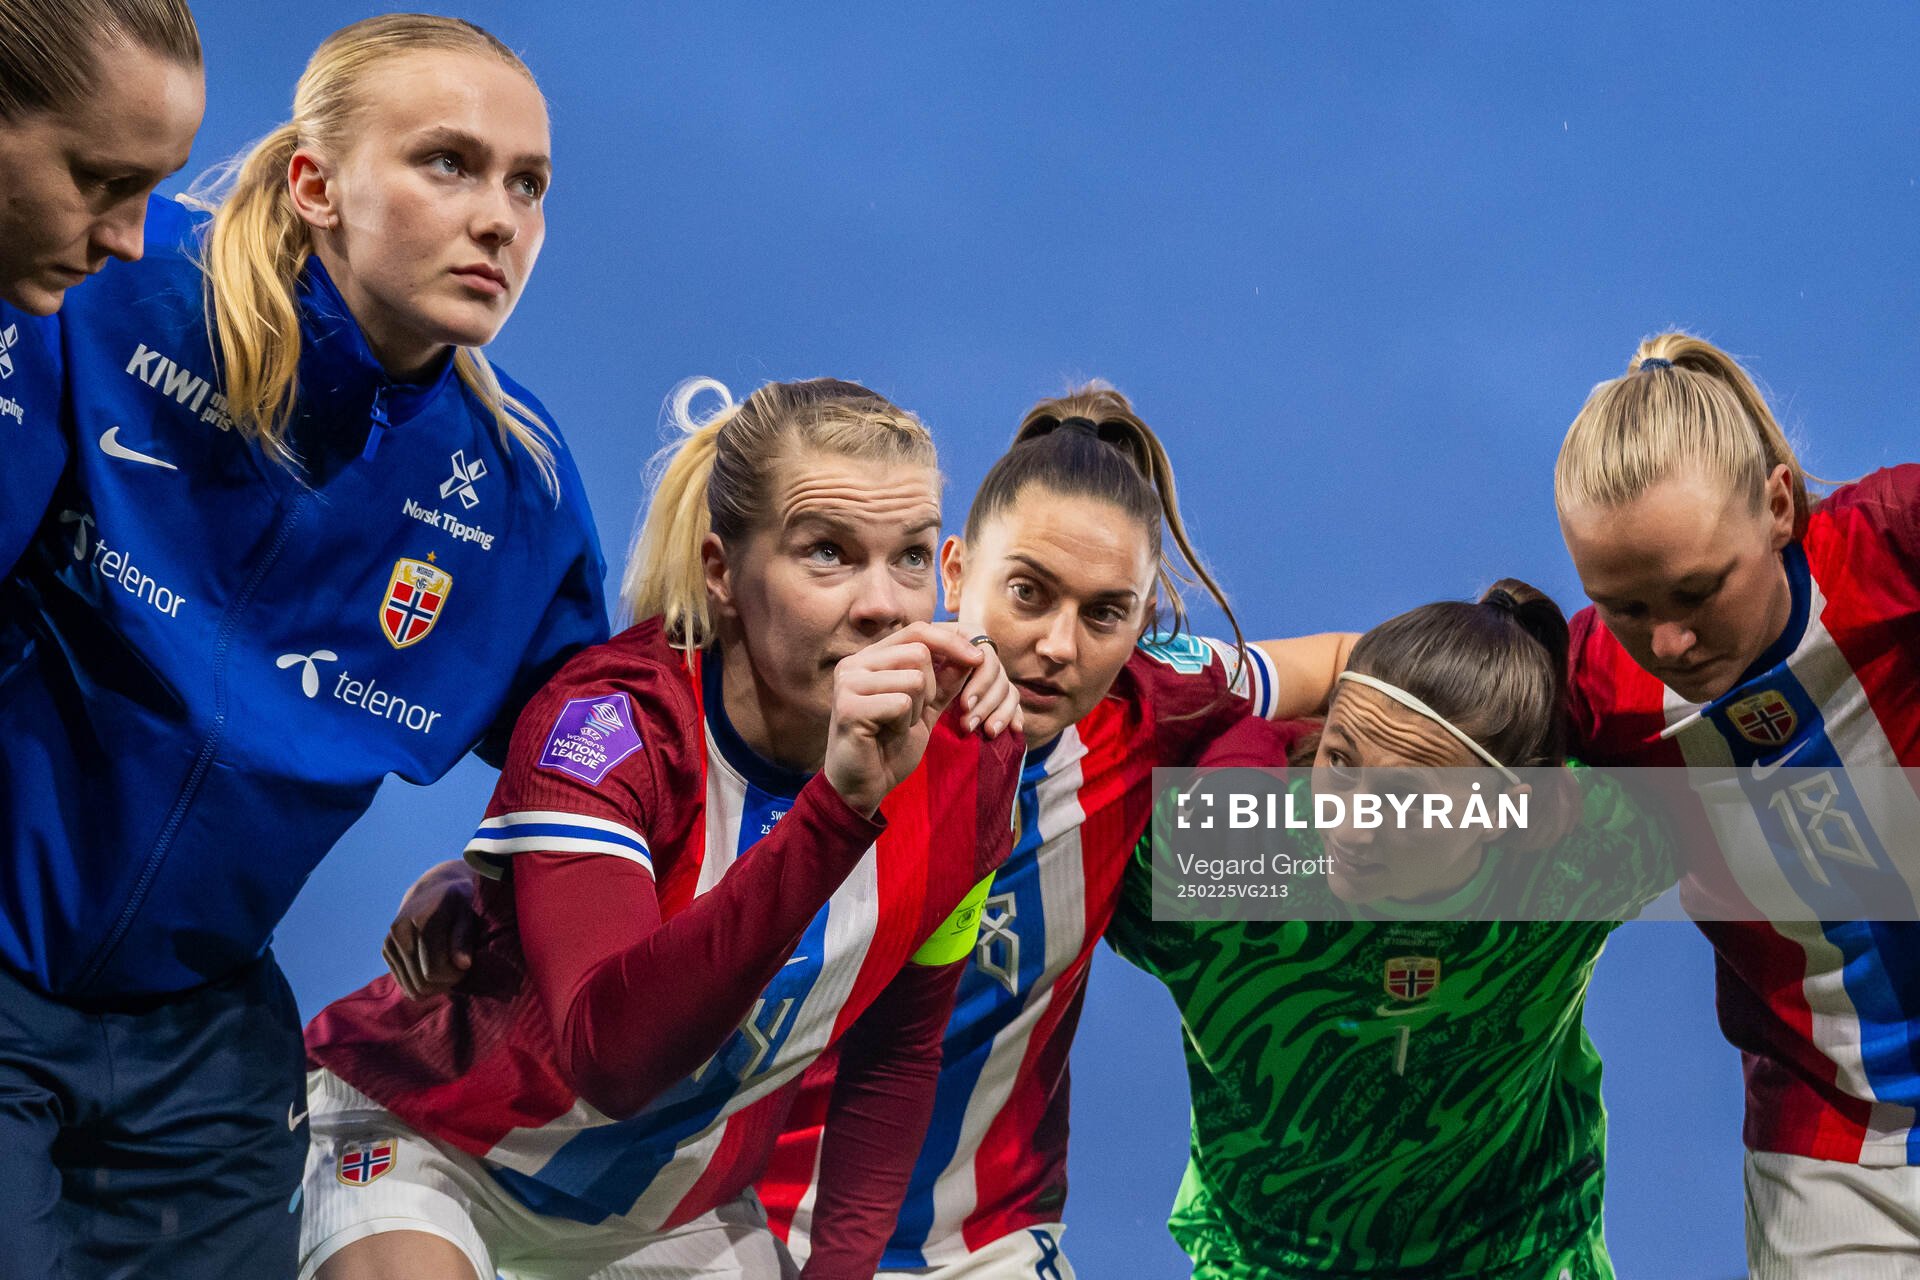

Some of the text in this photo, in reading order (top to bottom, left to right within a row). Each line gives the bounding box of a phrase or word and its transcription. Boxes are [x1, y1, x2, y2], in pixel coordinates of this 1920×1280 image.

[125, 343, 210, 413] KIWI
[402, 498, 494, 550] Norsk Tipping
[92, 539, 186, 618] telenor
[333, 671, 441, 734] telenor
[551, 747, 600, 770] LEAGUE
[553, 738, 607, 763] NATIONS
[1768, 771, 1879, 887] 18
[977, 891, 1020, 997] 8
